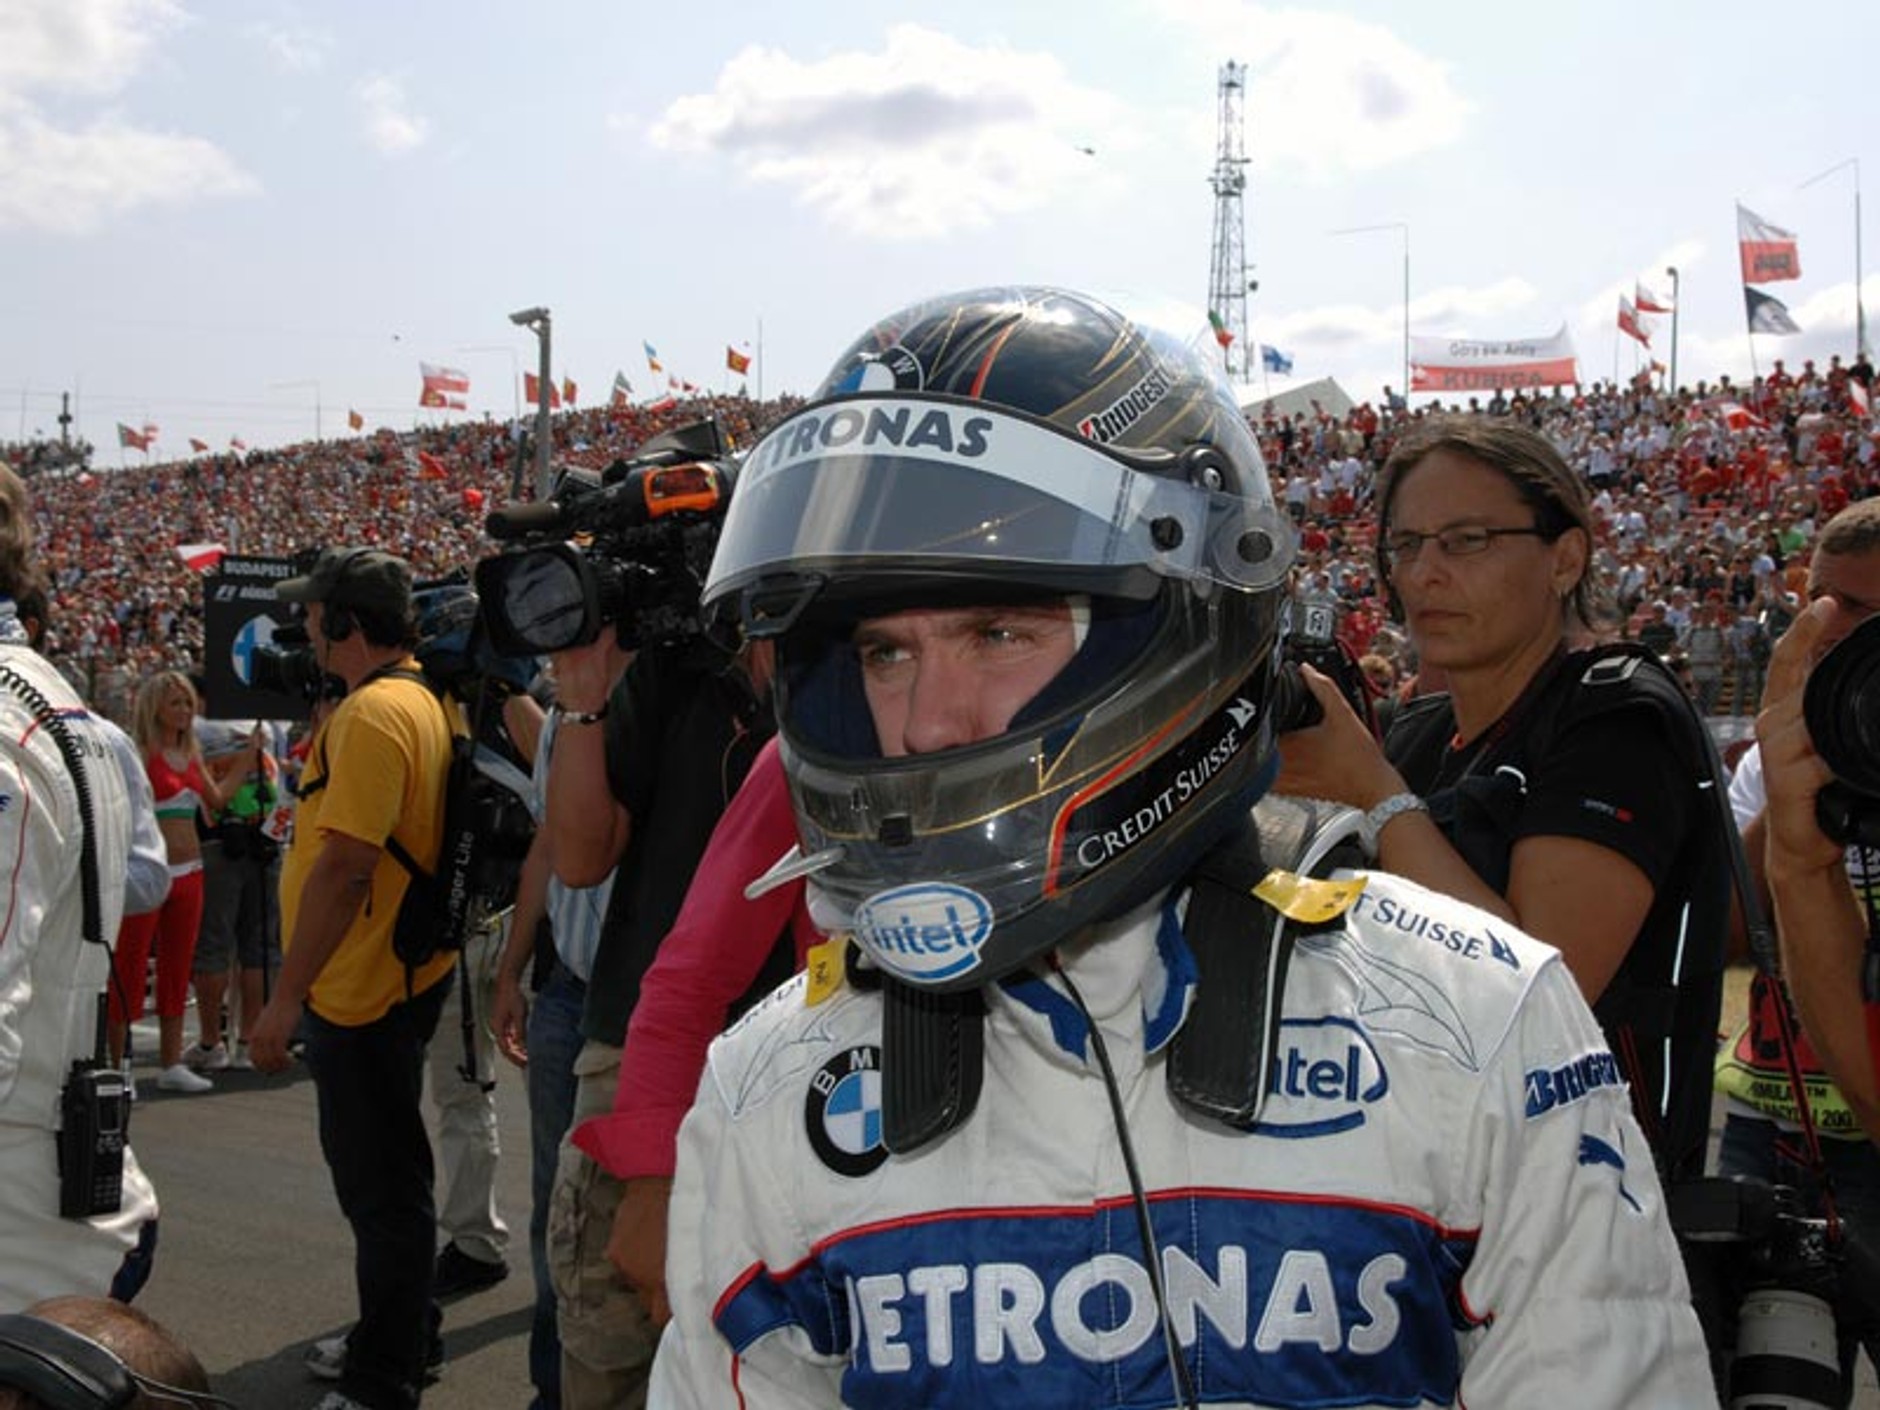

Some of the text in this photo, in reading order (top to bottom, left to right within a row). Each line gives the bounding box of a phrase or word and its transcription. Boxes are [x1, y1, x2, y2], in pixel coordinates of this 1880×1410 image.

[753, 407, 993, 478] ETRONAS
[223, 560, 289, 578] BUDAPEST
[1078, 728, 1241, 868] CREDIT SUISSE
[865, 904, 968, 955] intel
[1373, 898, 1484, 961] SUISSE
[813, 1047, 874, 1096] BM
[845, 1245, 1407, 1374] ETRONAS
